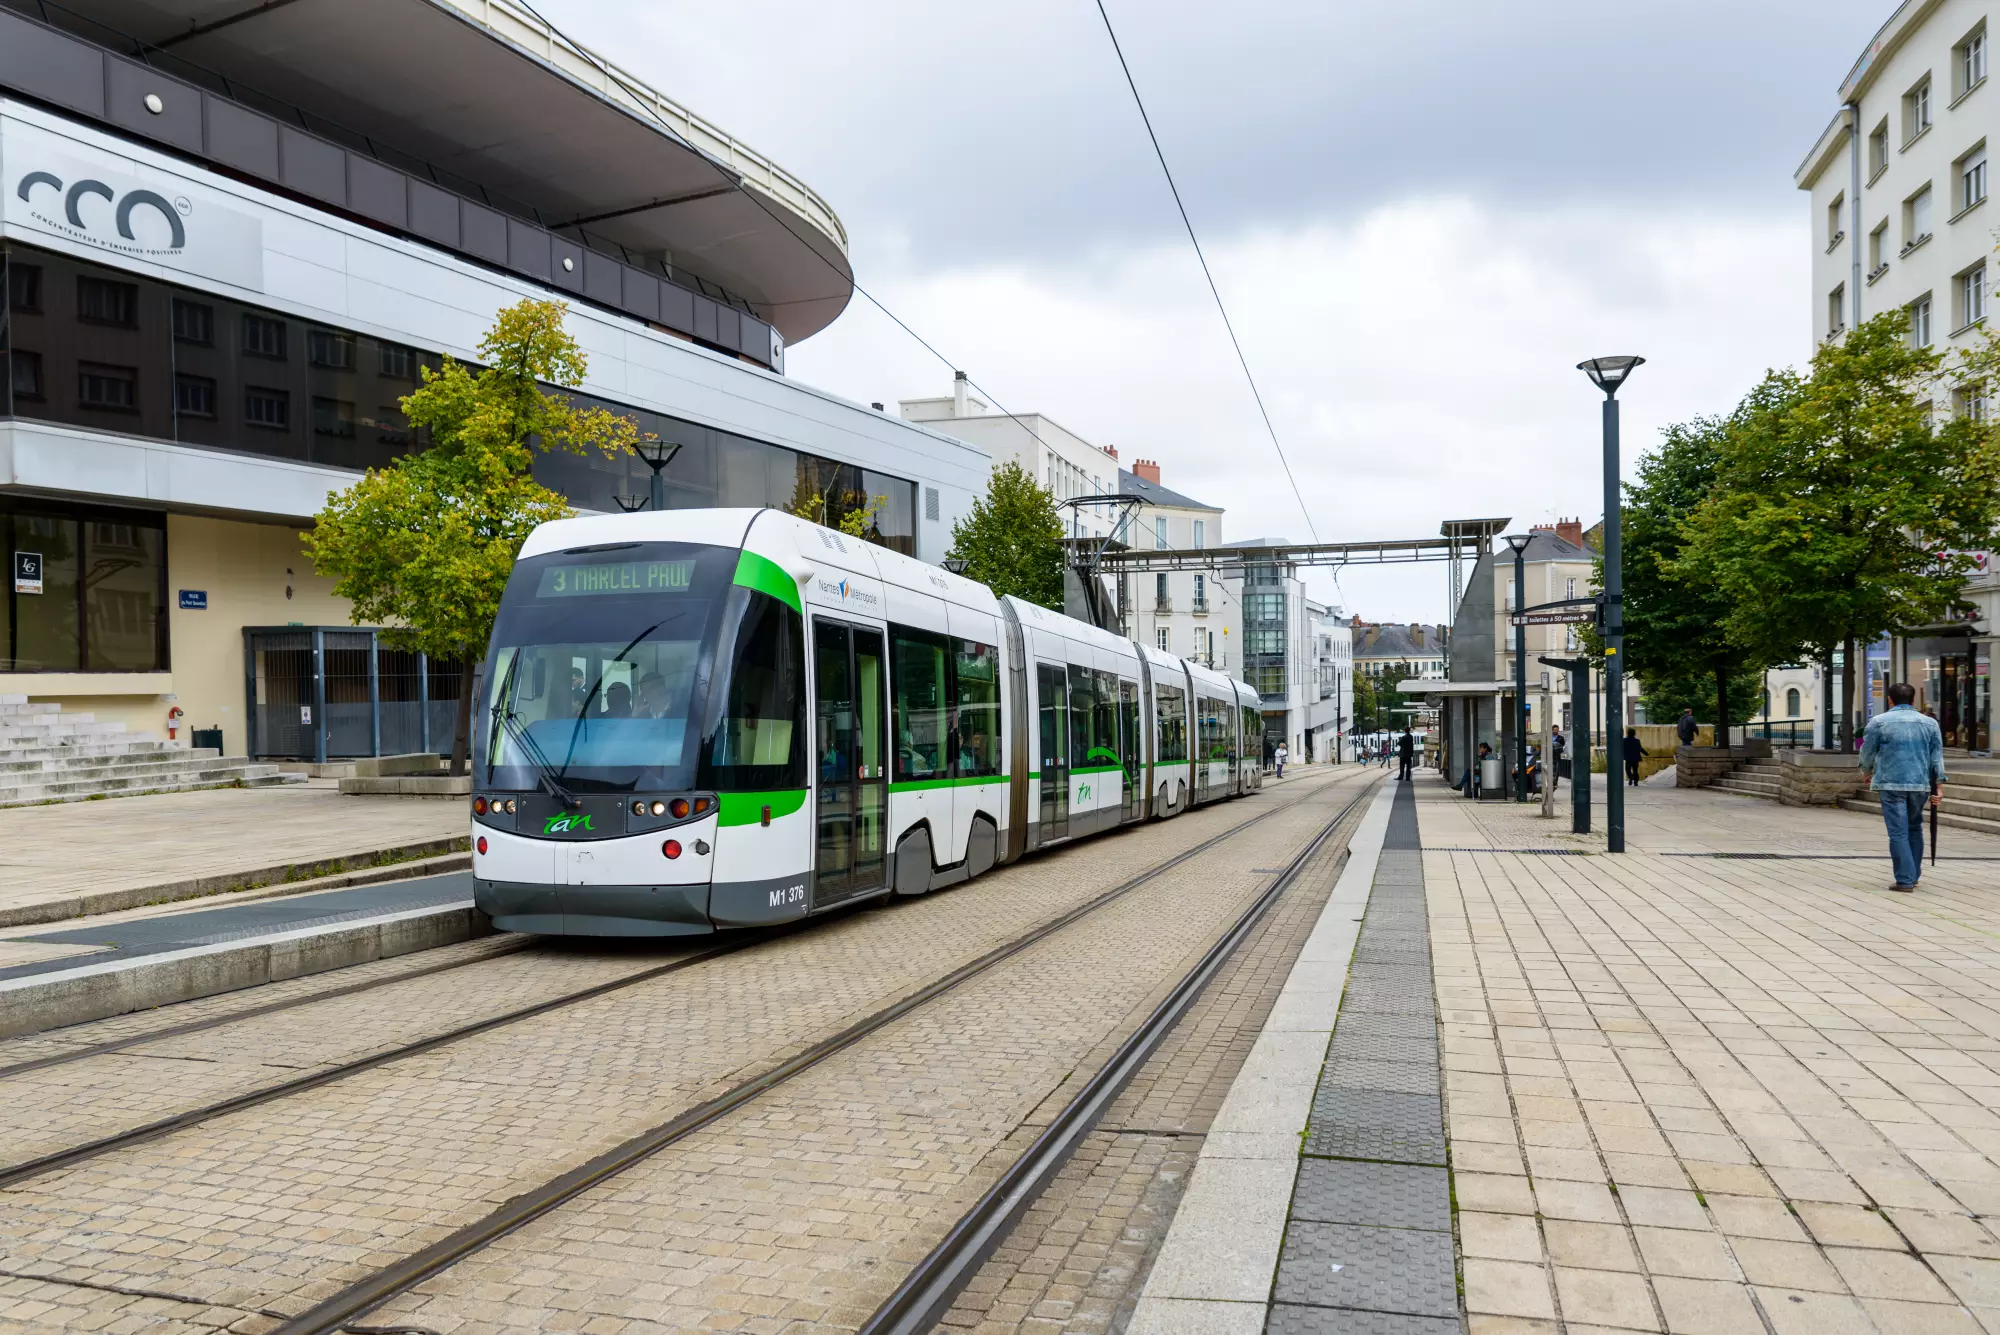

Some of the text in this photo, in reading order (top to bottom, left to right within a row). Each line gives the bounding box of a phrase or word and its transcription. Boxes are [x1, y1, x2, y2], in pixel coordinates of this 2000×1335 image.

[31, 211, 97, 243] CONCENTRATEUR
[553, 563, 690, 592] 3 MARCEL PAUL
[818, 579, 840, 595] Nantes
[543, 811, 596, 835] tan
[769, 884, 804, 907] M1 376
